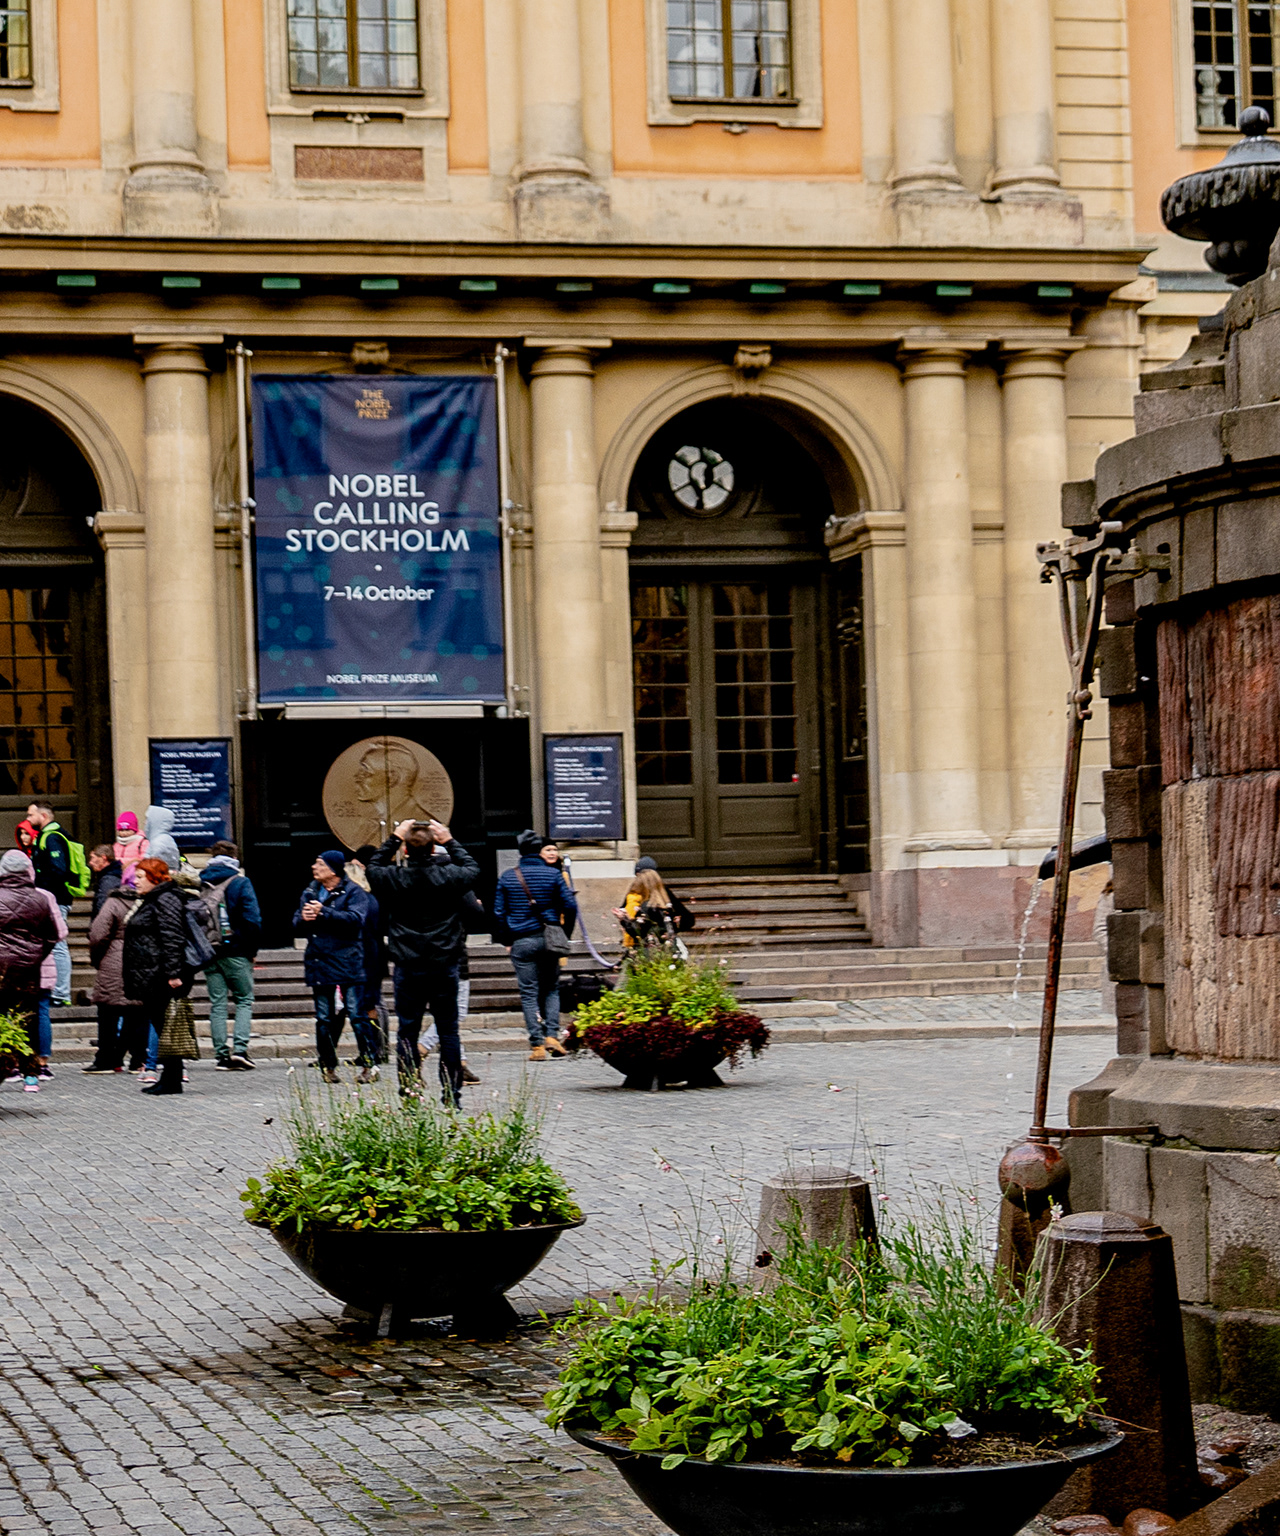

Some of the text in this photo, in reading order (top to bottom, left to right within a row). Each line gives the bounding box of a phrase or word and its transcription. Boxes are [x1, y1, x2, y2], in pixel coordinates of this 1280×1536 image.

[362, 388, 383, 398] THE
[354, 399, 393, 410] NOBEL
[357, 408, 389, 419] PRIZE
[328, 474, 425, 497] NOBEL
[313, 501, 440, 525] CALLING
[285, 529, 470, 552] STOCKHOLM
[365, 585, 435, 601] October
[326, 673, 439, 684] NOBEL PRIZE MUSEUM
